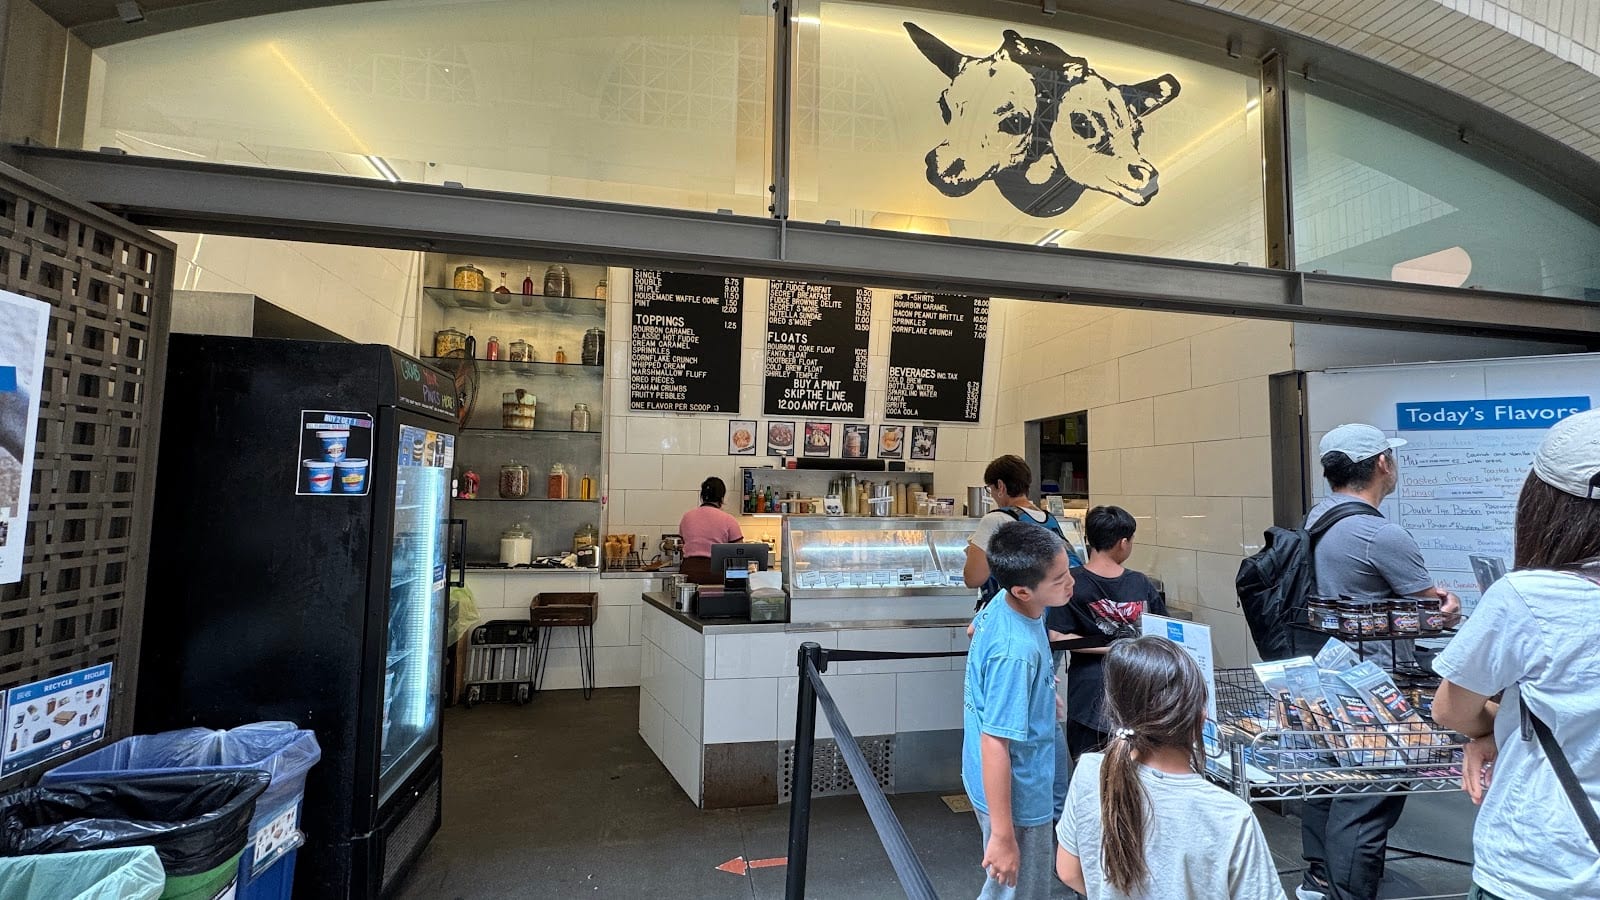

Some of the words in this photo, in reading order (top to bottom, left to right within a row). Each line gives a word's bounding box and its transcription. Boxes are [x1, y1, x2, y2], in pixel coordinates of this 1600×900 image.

[635, 271, 661, 279] SINGLE
[635, 285, 660, 293] TRIPLE
[786, 283, 804, 291] FUDGE
[634, 292, 674, 302] HOUSEMADE
[675, 294, 700, 304] WAFFLE
[702, 297, 720, 305] CONE
[798, 291, 832, 300] BREAKFAST
[770, 296, 790, 304] FUDGE
[792, 298, 819, 307] BROWNIE
[769, 303, 794, 311] SECRET
[914, 311, 937, 319] PEANUT
[636, 314, 685, 327] TOPPINGS
[893, 318, 926, 326] SPRINKLES
[633, 325, 663, 334] BOURBON
[892, 326, 928, 335] CORNFLAKE
[768, 332, 807, 343] FLOATS
[659, 341, 690, 349] CARAMEL
[768, 343, 795, 351] BOURBON
[632, 347, 670, 355] SPRINKLES
[672, 356, 698, 364] CRUNCH
[401, 360, 420, 381] GRAB
[632, 368, 683, 376] MARSHMALLOW
[890, 366, 936, 379] BEVERAGES
[794, 379, 810, 389] BUY
[814, 380, 819, 389] A
[821, 380, 841, 390] PINT
[784, 389, 805, 398] SKIP
[806, 390, 823, 400] THE
[826, 391, 846, 401] LINE
[801, 401, 819, 410] ANY
[820, 401, 853, 412] FLAVOR
[1406, 406, 1484, 425] Today's
[1495, 405, 1578, 421] Flavors
[44, 678, 72, 692] RECYCLE
